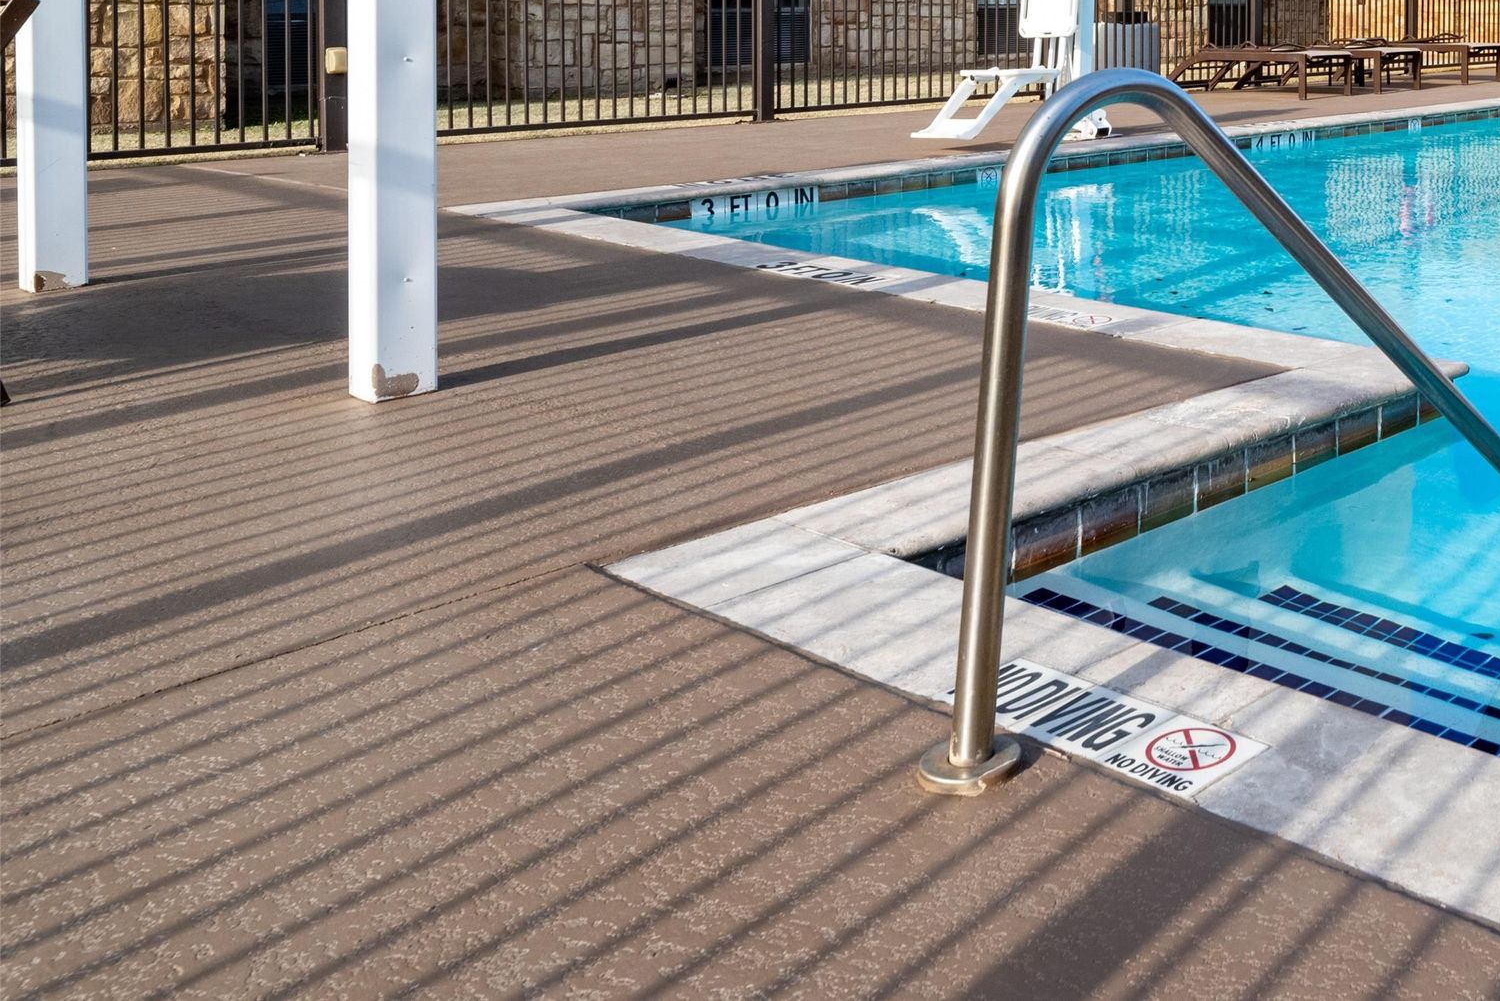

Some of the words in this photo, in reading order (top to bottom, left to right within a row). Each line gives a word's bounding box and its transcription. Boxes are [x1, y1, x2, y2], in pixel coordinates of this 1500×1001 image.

[1256, 136, 1264, 147] 4
[1270, 134, 1282, 146] FT
[1303, 131, 1312, 142] IN
[701, 198, 714, 215] 3
[730, 194, 752, 212] FT
[795, 187, 814, 204] IN
[996, 679, 1156, 752] DIVING
[1104, 753, 1136, 769] NO
[1130, 762, 1193, 791] DIVING
